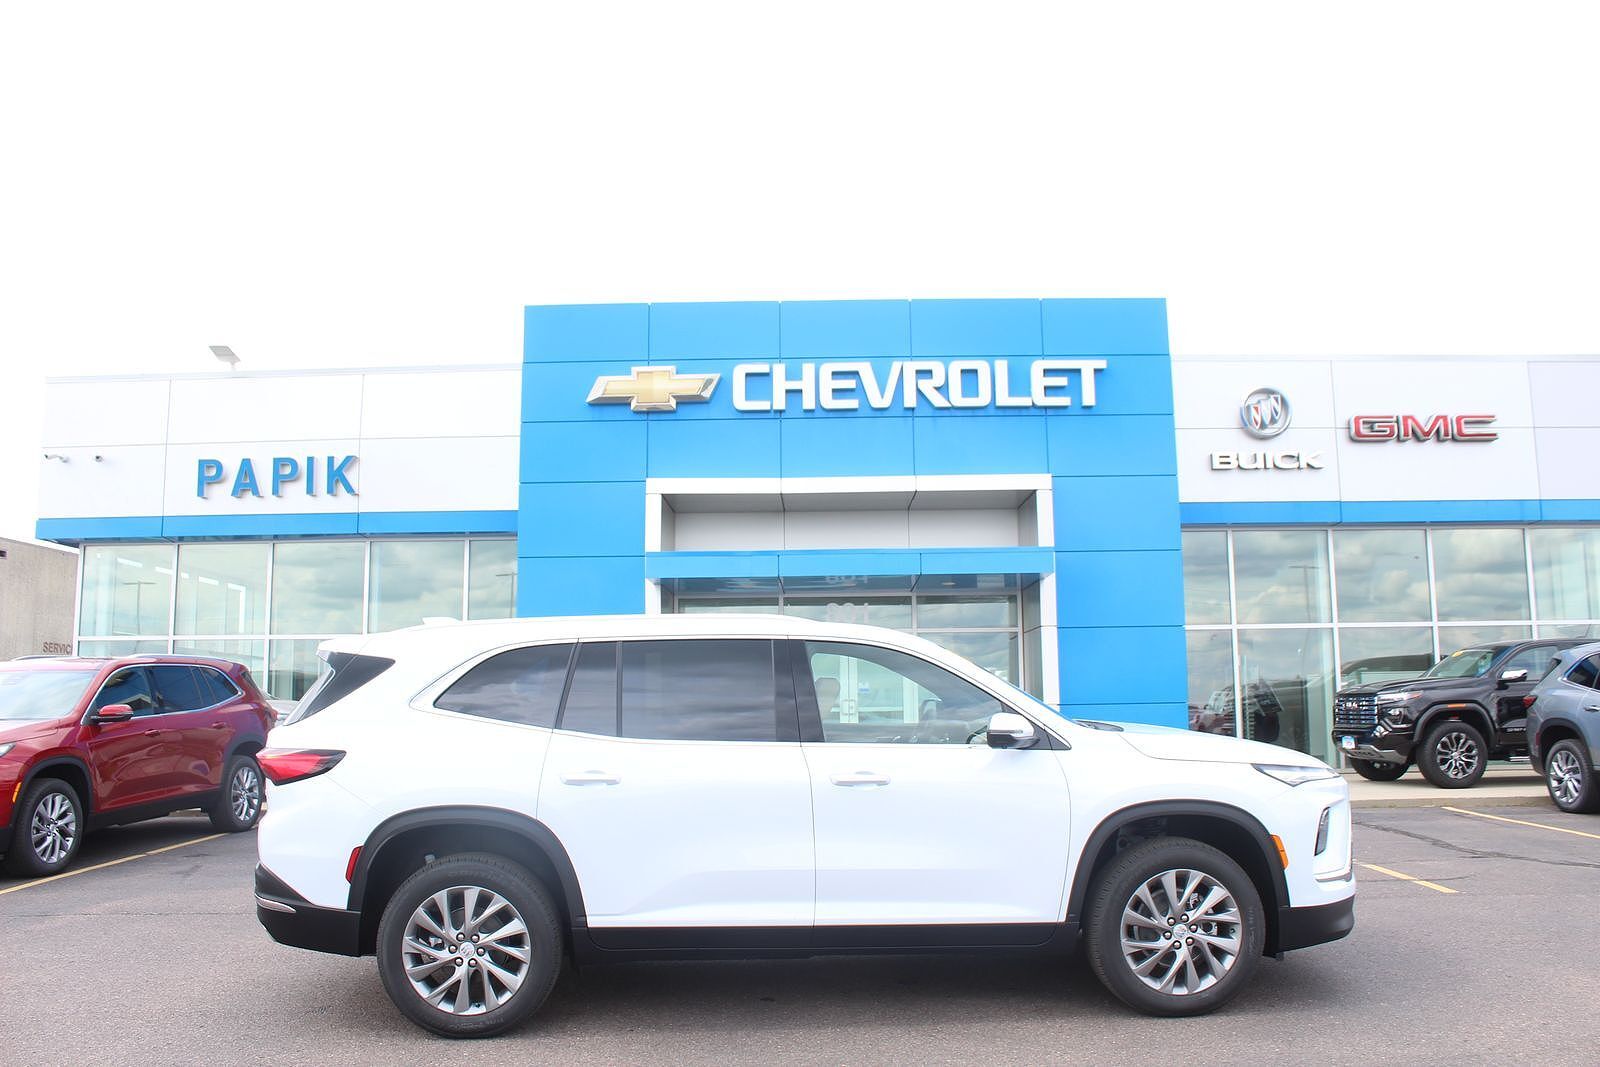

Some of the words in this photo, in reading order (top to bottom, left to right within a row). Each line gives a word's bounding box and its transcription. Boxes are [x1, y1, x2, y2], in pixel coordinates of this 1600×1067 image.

[732, 359, 1107, 411] CHEVROLET
[1349, 415, 1498, 443] GMC
[1210, 452, 1324, 471] BUICK
[197, 455, 359, 499] PAPIK
[42, 641, 73, 655] SERVIC
